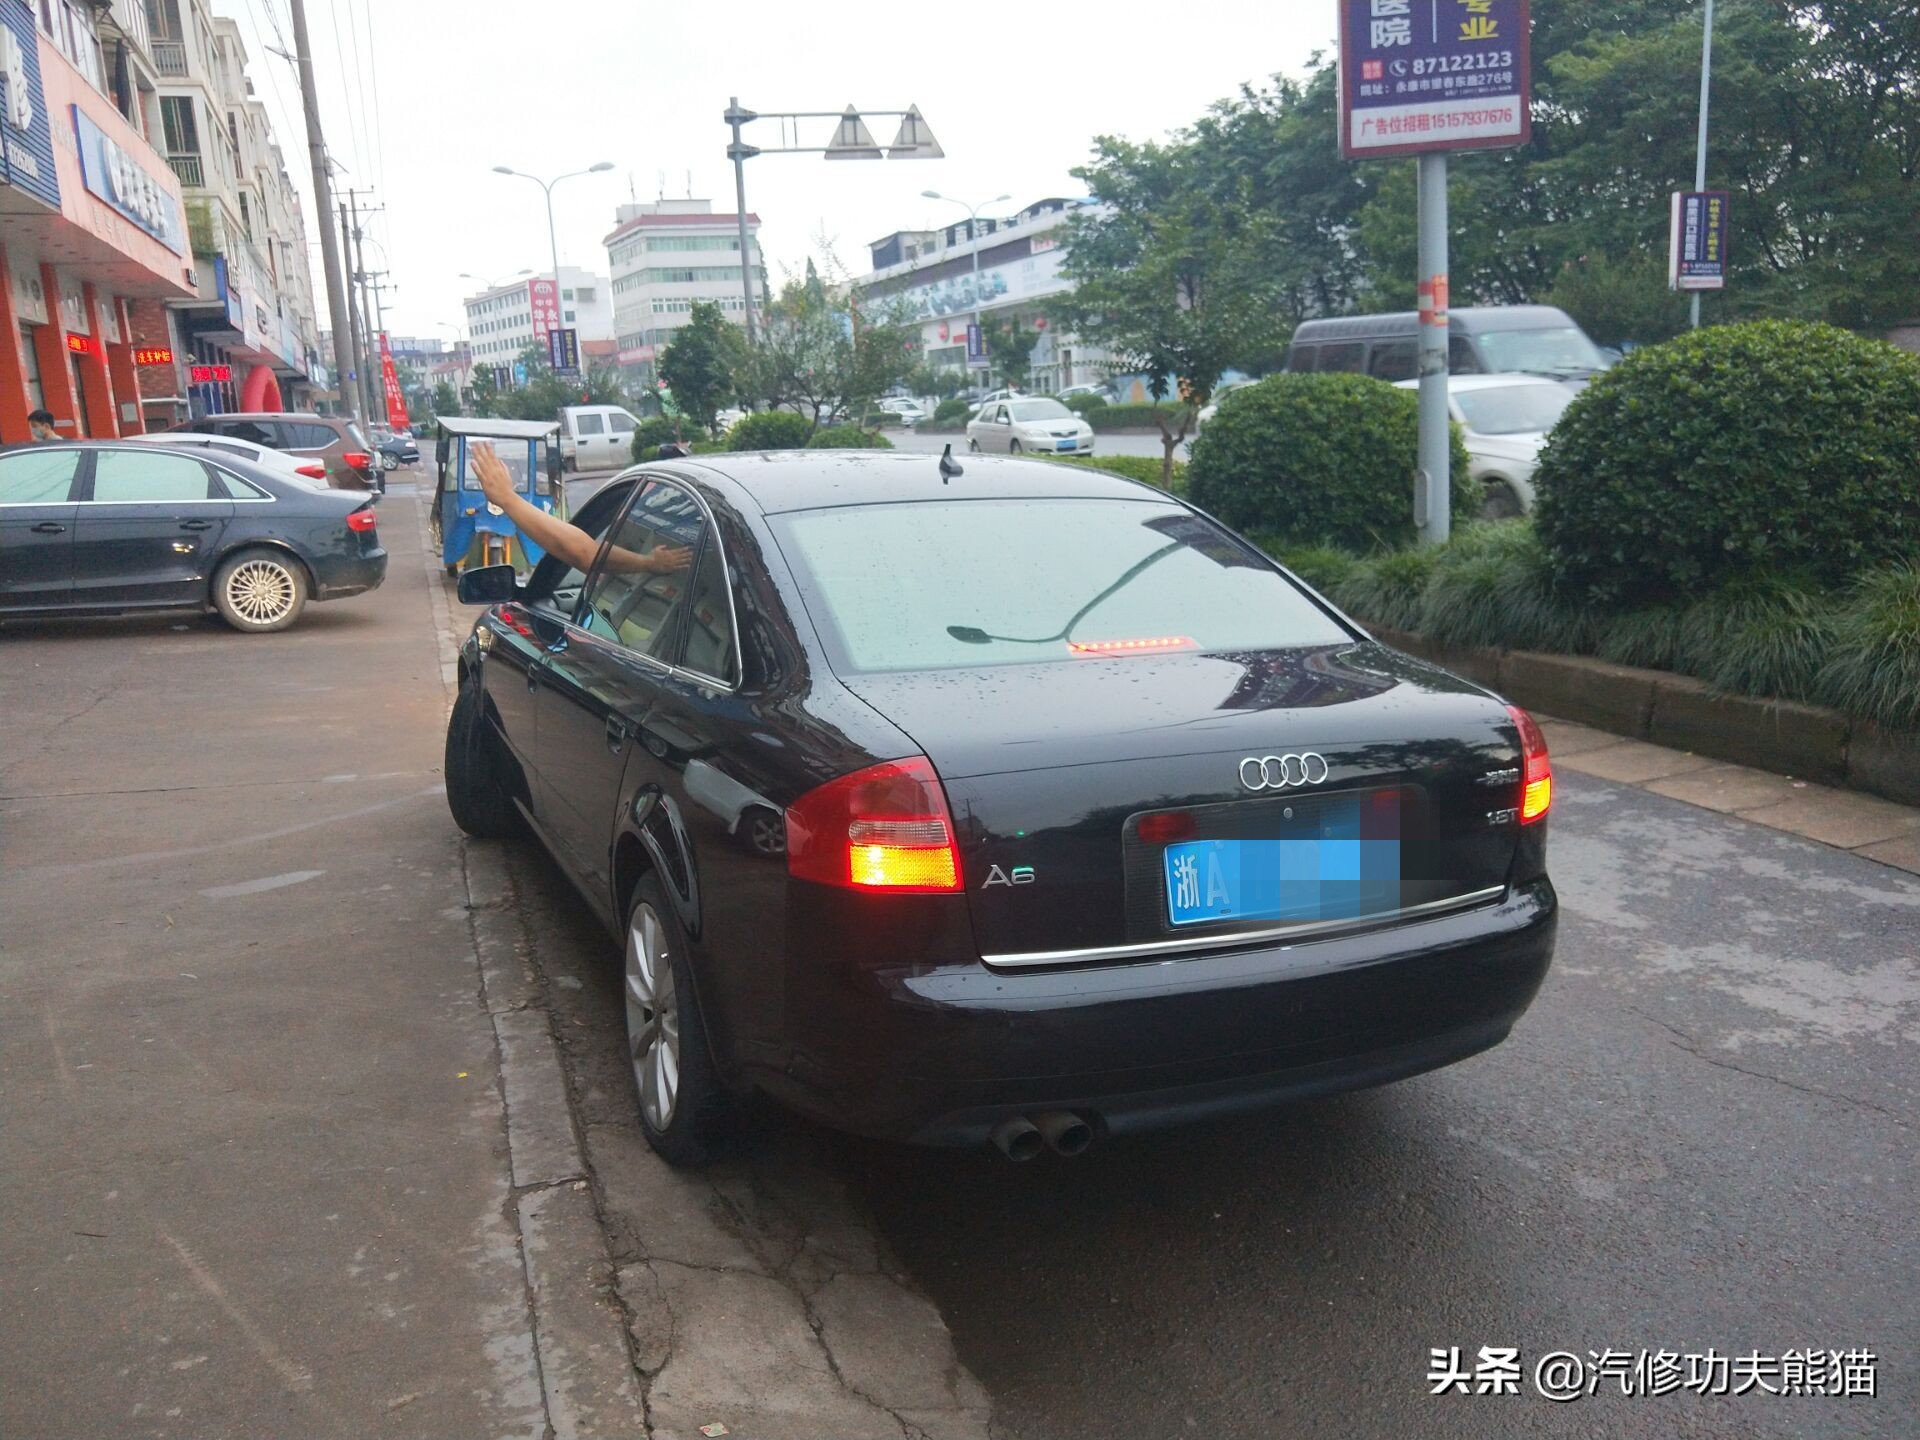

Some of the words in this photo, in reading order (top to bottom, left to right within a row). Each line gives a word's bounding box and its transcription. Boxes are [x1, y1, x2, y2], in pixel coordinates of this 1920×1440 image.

[1413, 51, 1512, 75] 87122123
[1361, 108, 1512, 137] 广告位招租15157937676
[980, 864, 1036, 889] A6
